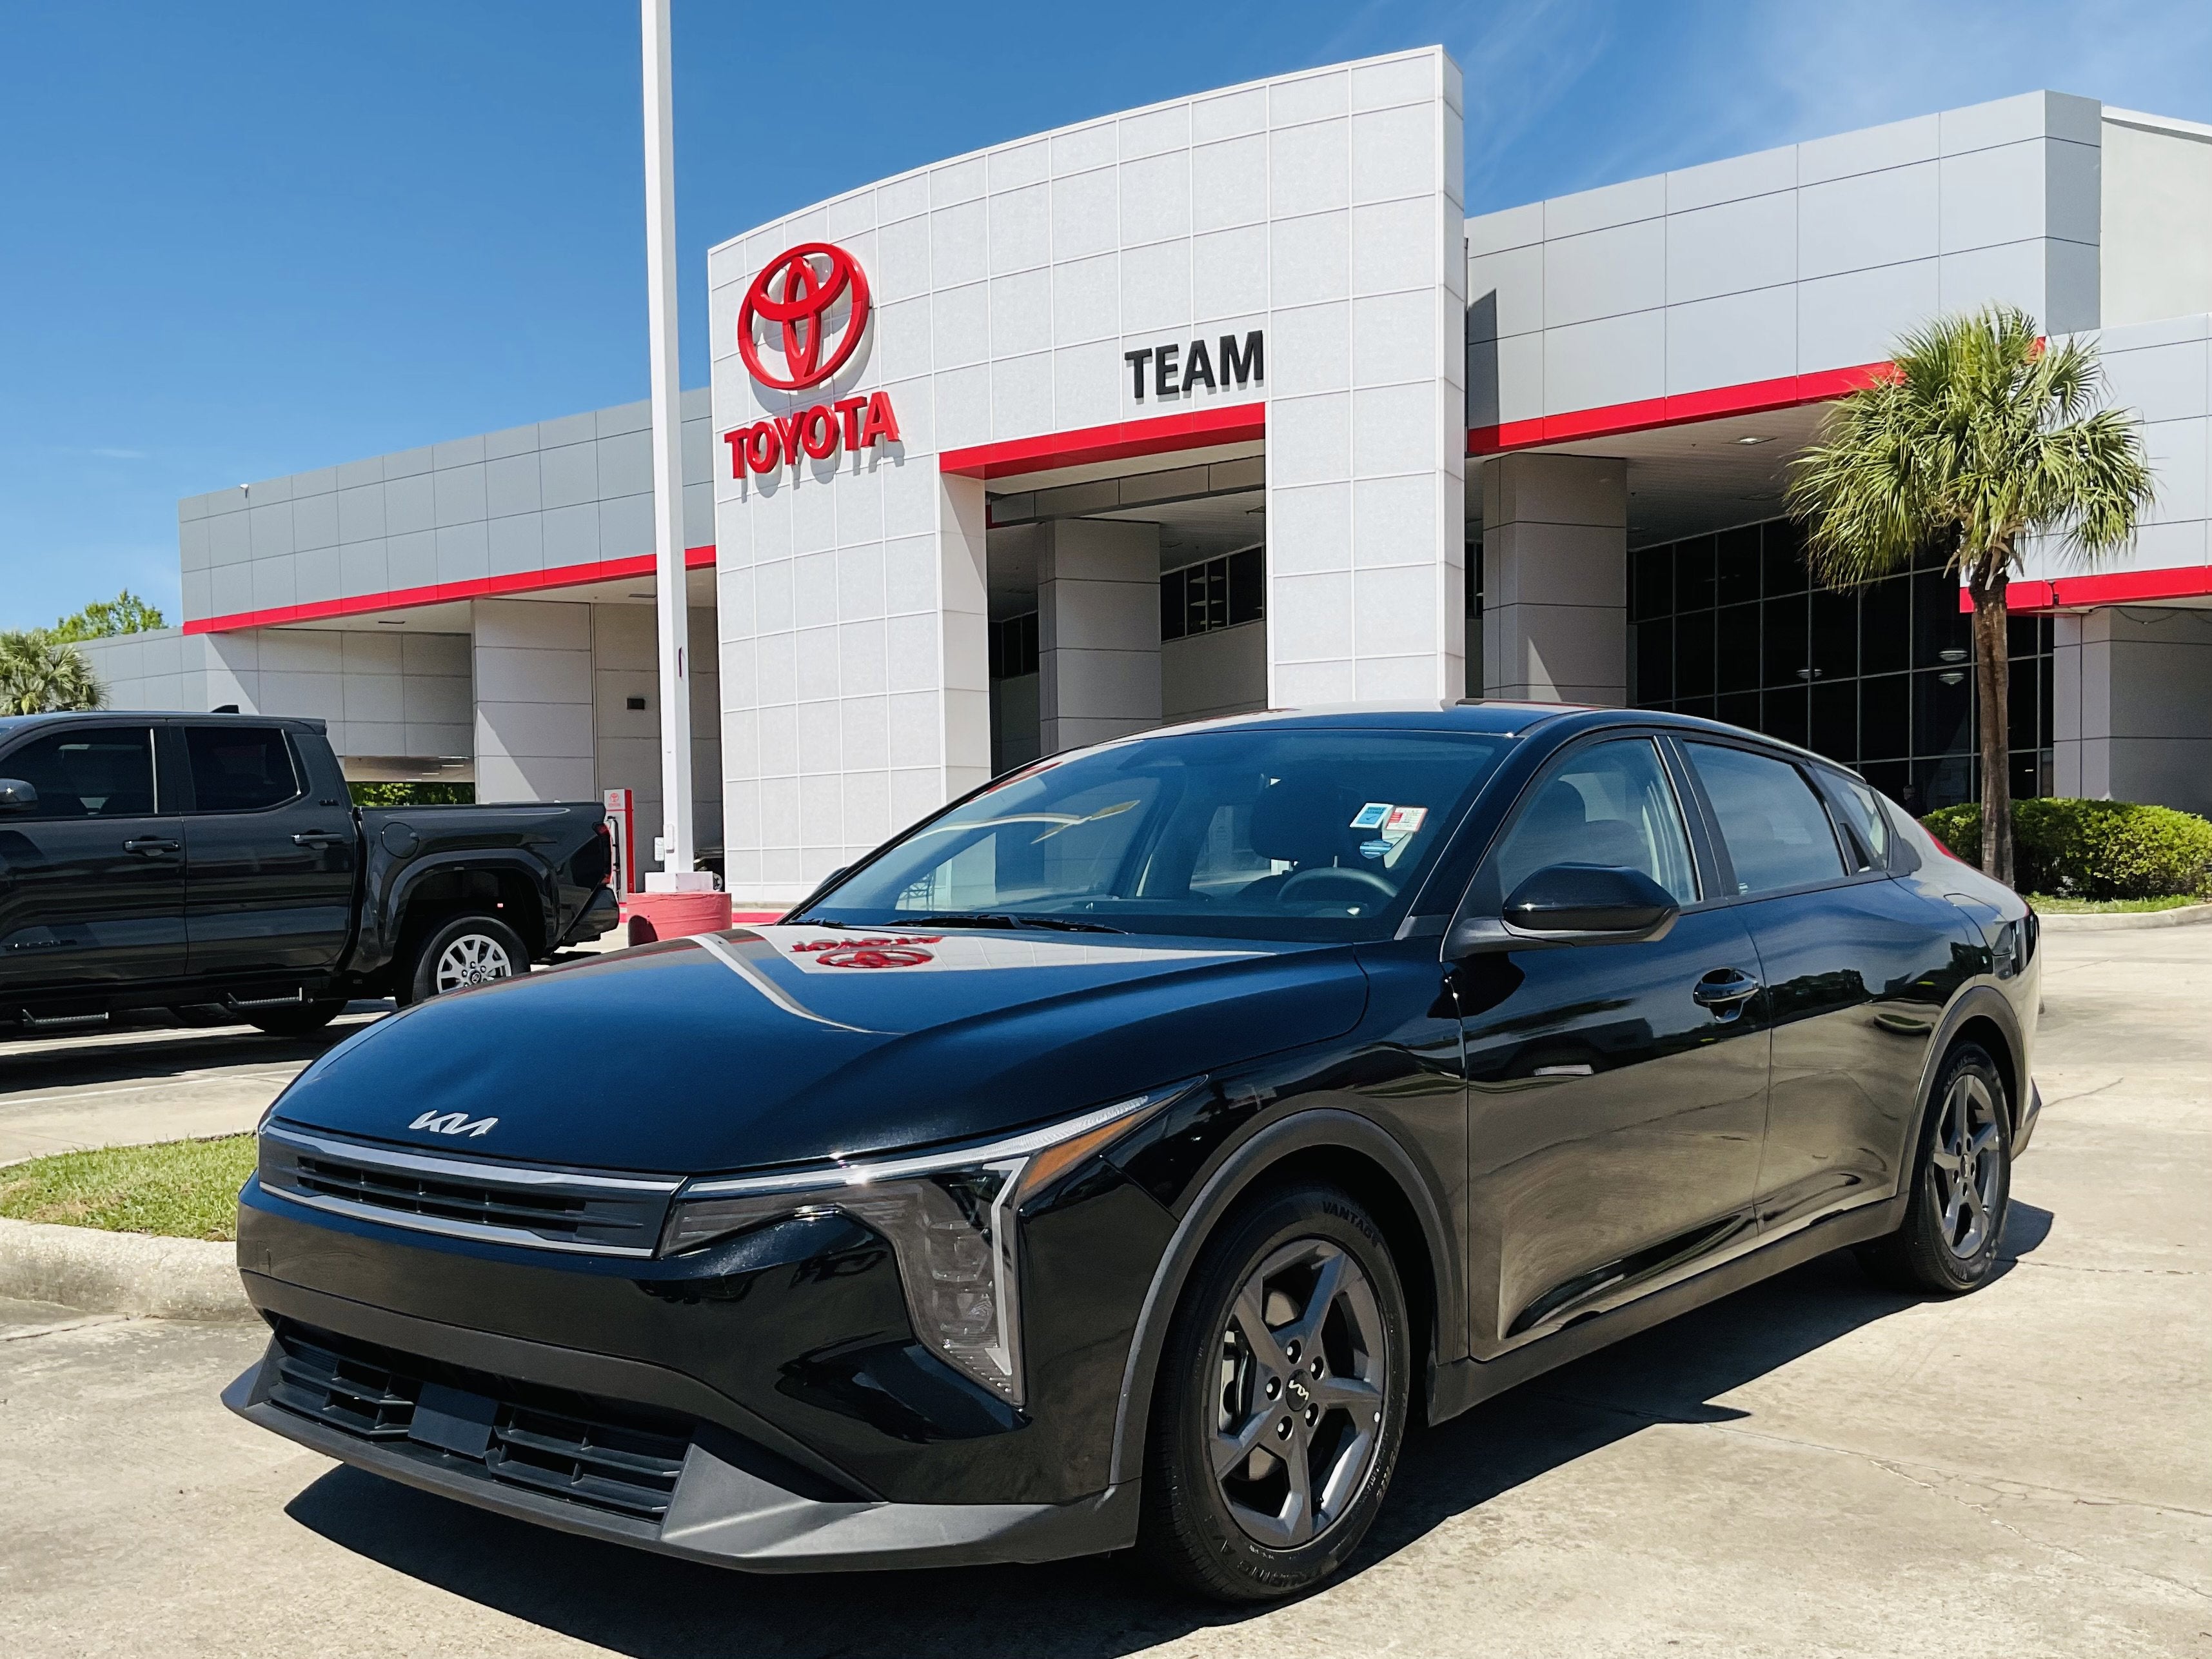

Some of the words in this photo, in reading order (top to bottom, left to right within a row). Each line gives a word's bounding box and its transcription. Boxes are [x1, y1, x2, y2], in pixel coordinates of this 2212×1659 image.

[1125, 330, 1264, 398] TEAM
[725, 391, 901, 479] TOYOTA
[409, 1109, 499, 1138] KIA
